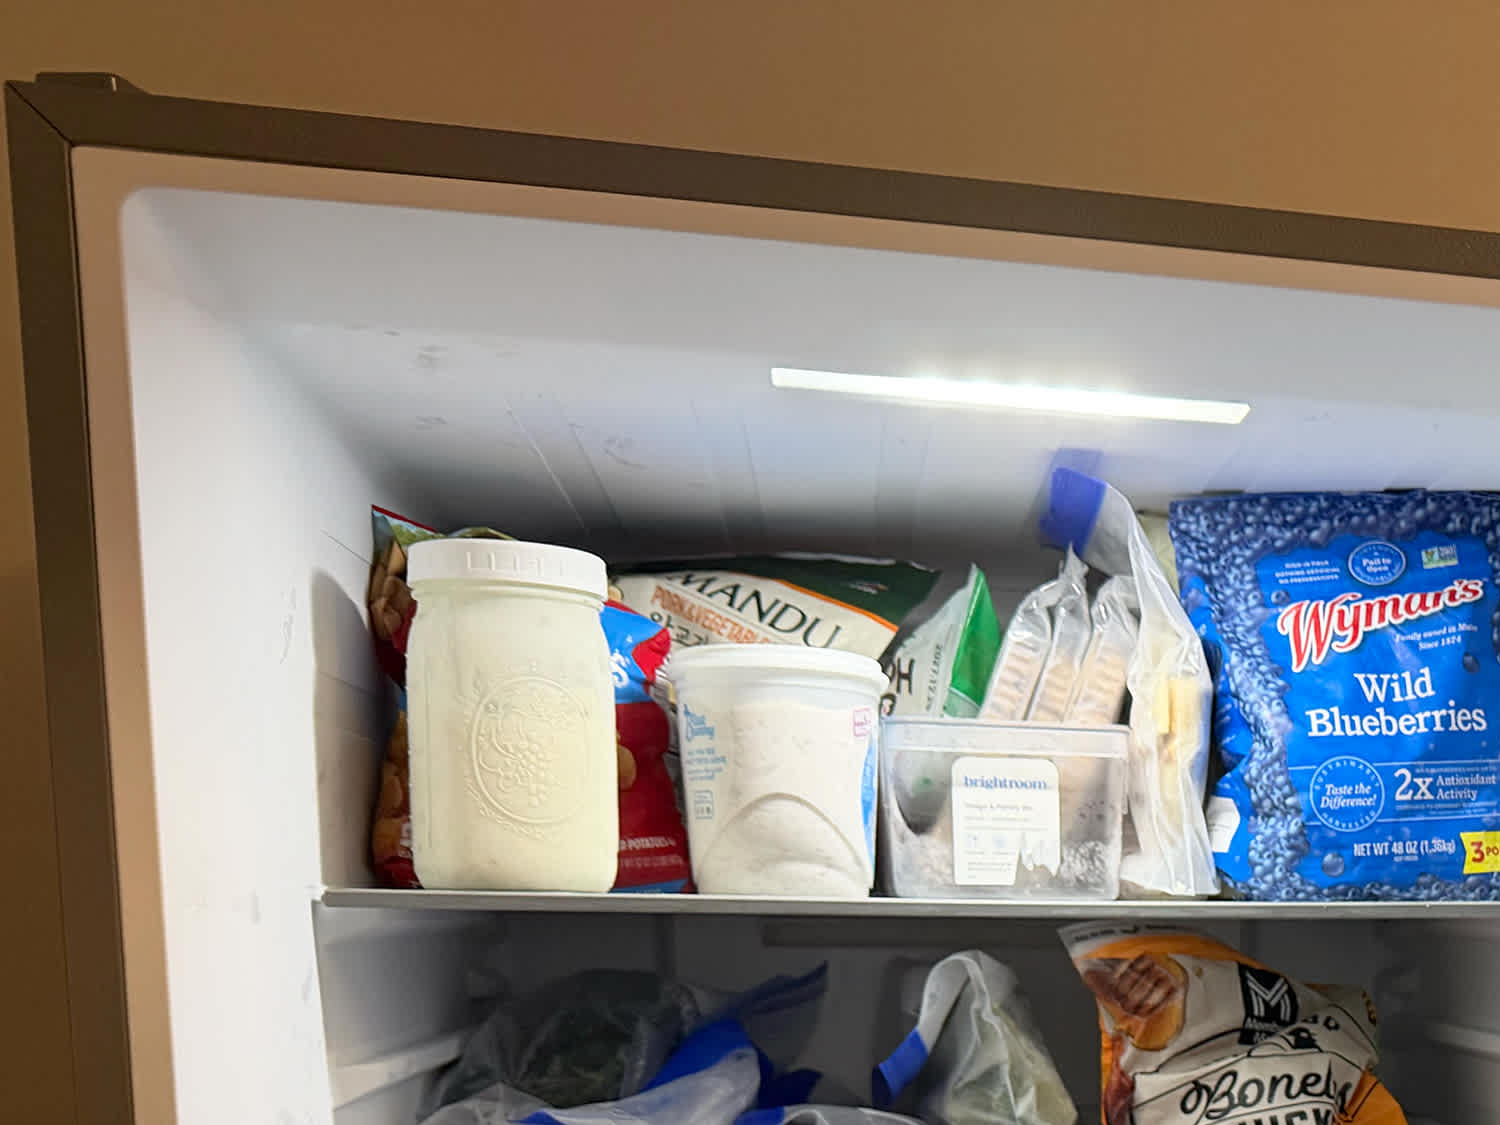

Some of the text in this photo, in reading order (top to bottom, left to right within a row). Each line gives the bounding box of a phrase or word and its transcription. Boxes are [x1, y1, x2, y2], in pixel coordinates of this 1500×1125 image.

[691, 604, 772, 643] VEGETABL
[1278, 578, 1485, 673] Wyman's
[1353, 667, 1436, 702] Wild
[1306, 701, 1488, 738] Blueberries
[963, 775, 1047, 790] brightroom
[1325, 783, 1372, 796] Taste the
[1393, 767, 1435, 801] 2x
[1436, 774, 1497, 787] Antioxidant
[1320, 794, 1377, 810] Difference!
[1436, 788, 1478, 801] Activity
[1353, 842, 1371, 857] NET
[1373, 840, 1389, 856] WT
[1391, 840, 1404, 855] 48
[1405, 840, 1418, 855] OZ
[1470, 841, 1486, 863] 3
